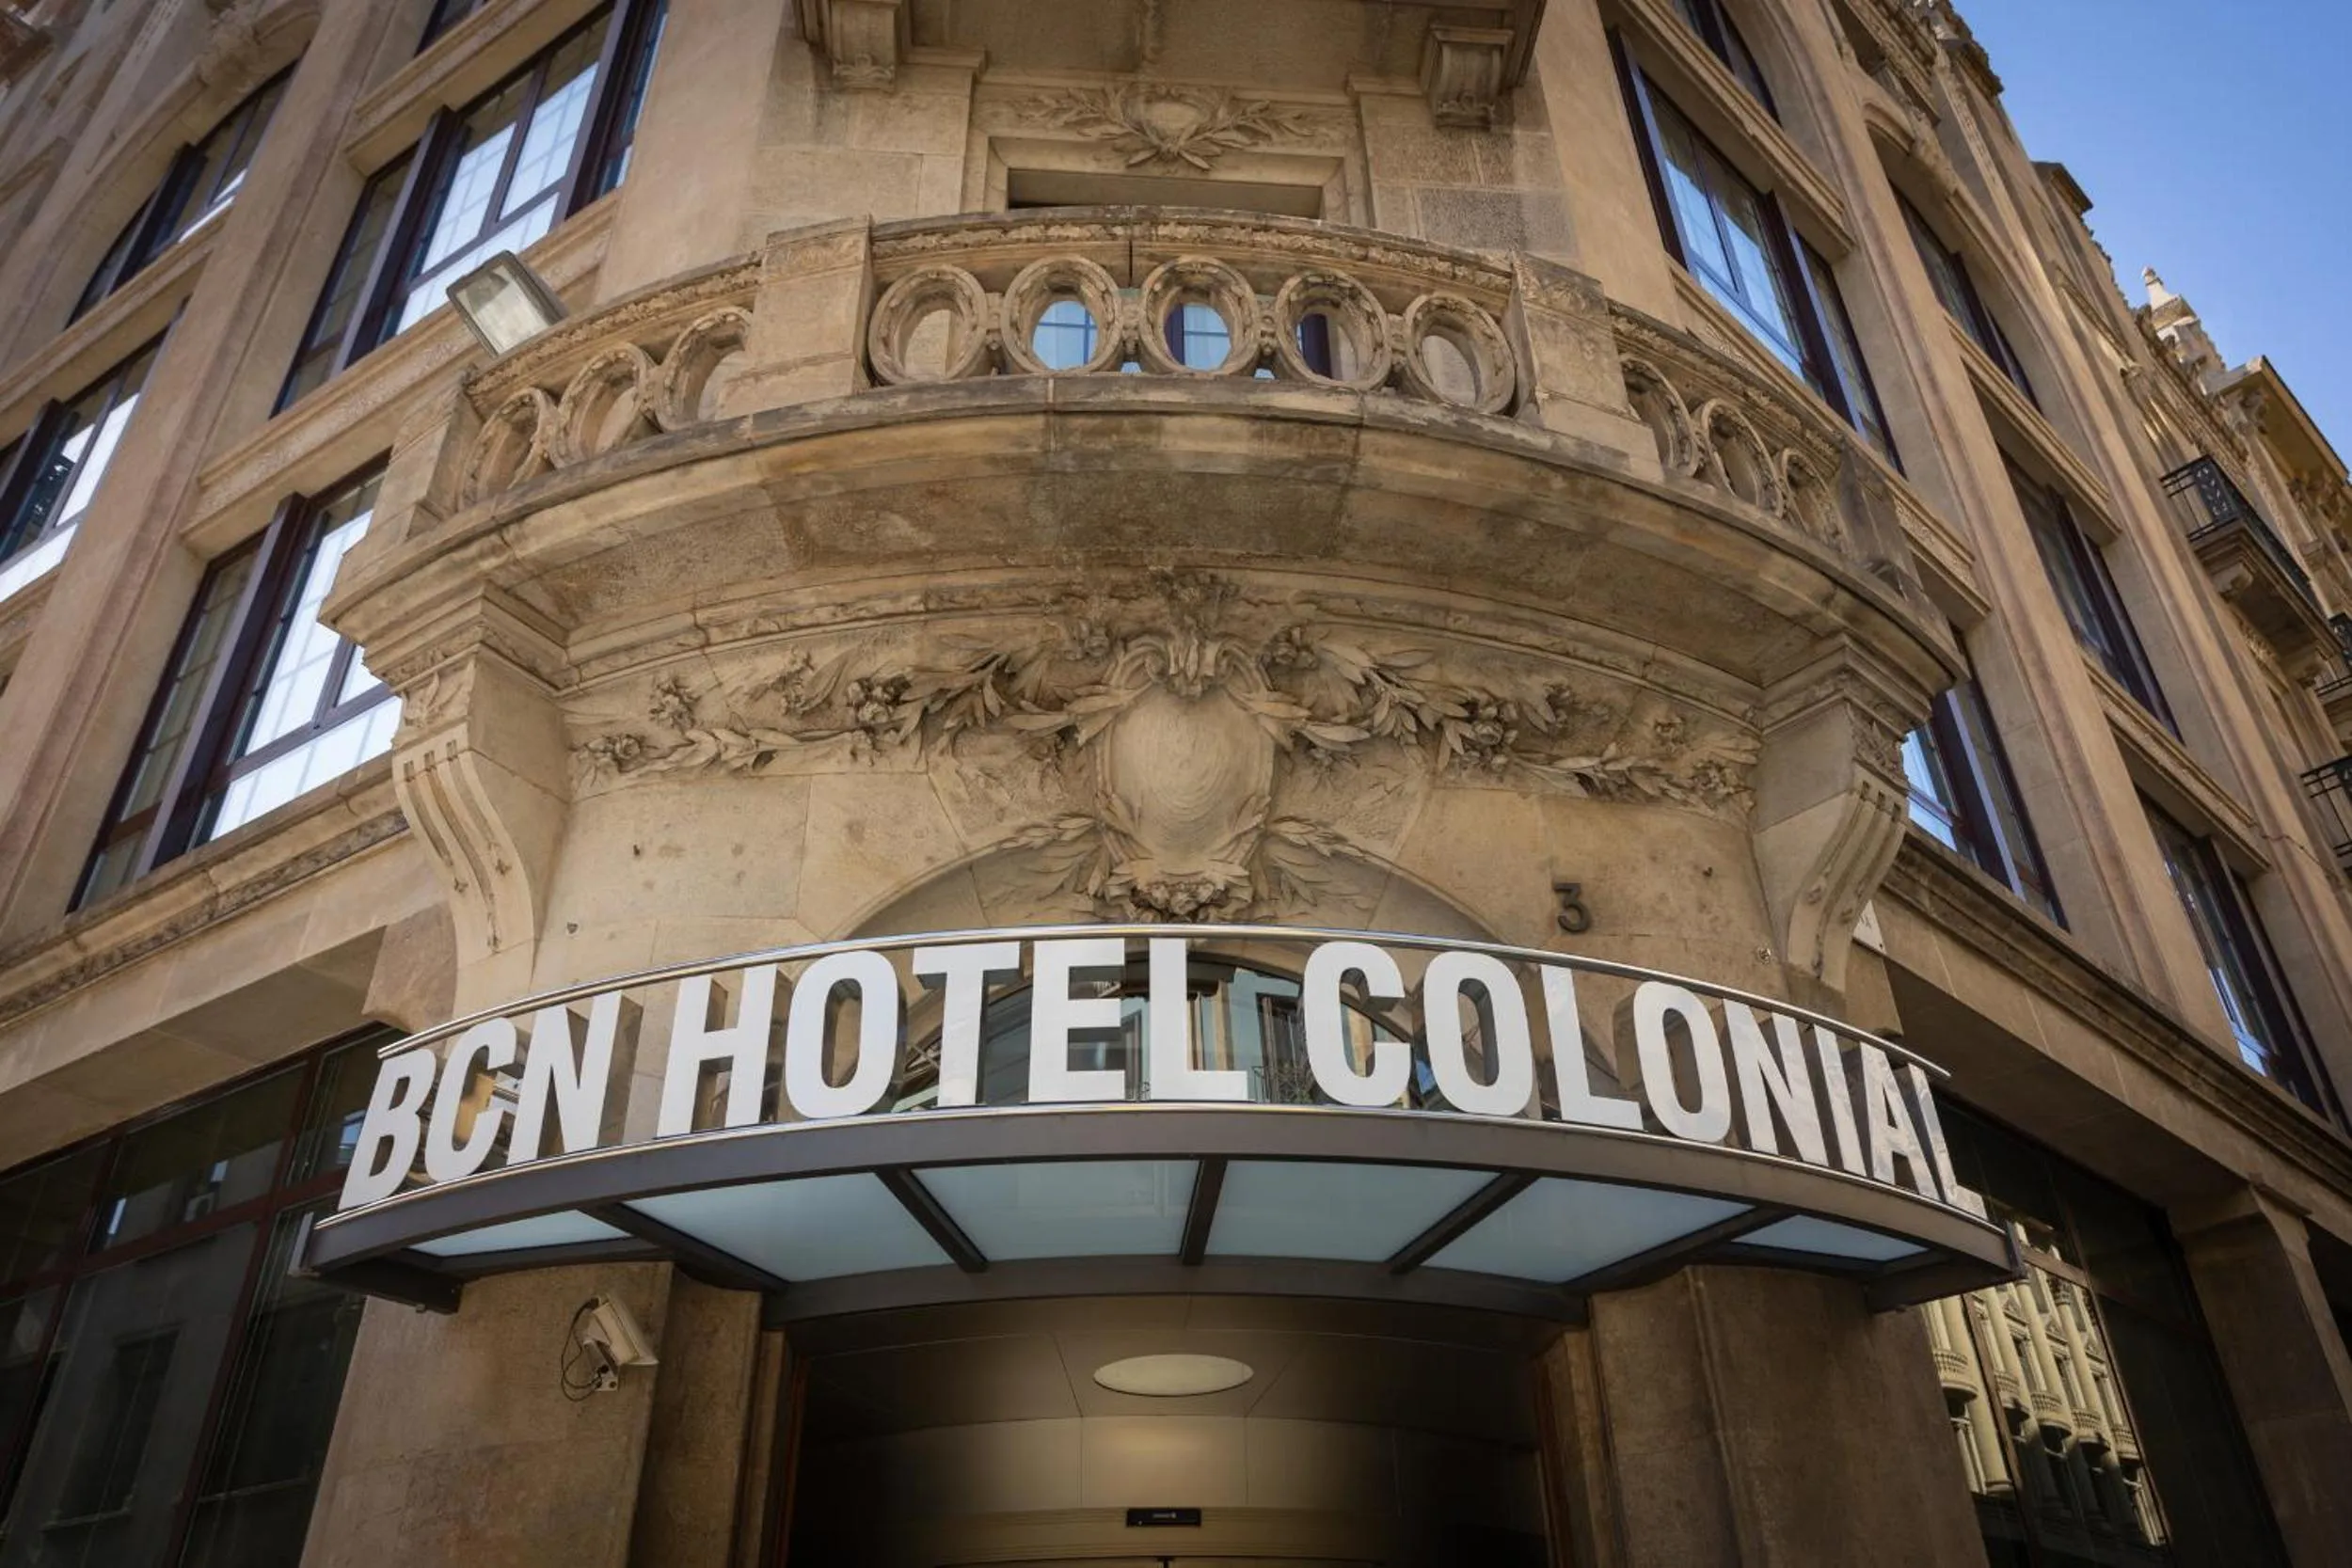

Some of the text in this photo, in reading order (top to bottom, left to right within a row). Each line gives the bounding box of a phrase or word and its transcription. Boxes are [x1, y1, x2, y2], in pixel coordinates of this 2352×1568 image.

[1552, 881, 1592, 934] 3
[337, 936, 1989, 1221] BCN HOTEL COLONIAL
